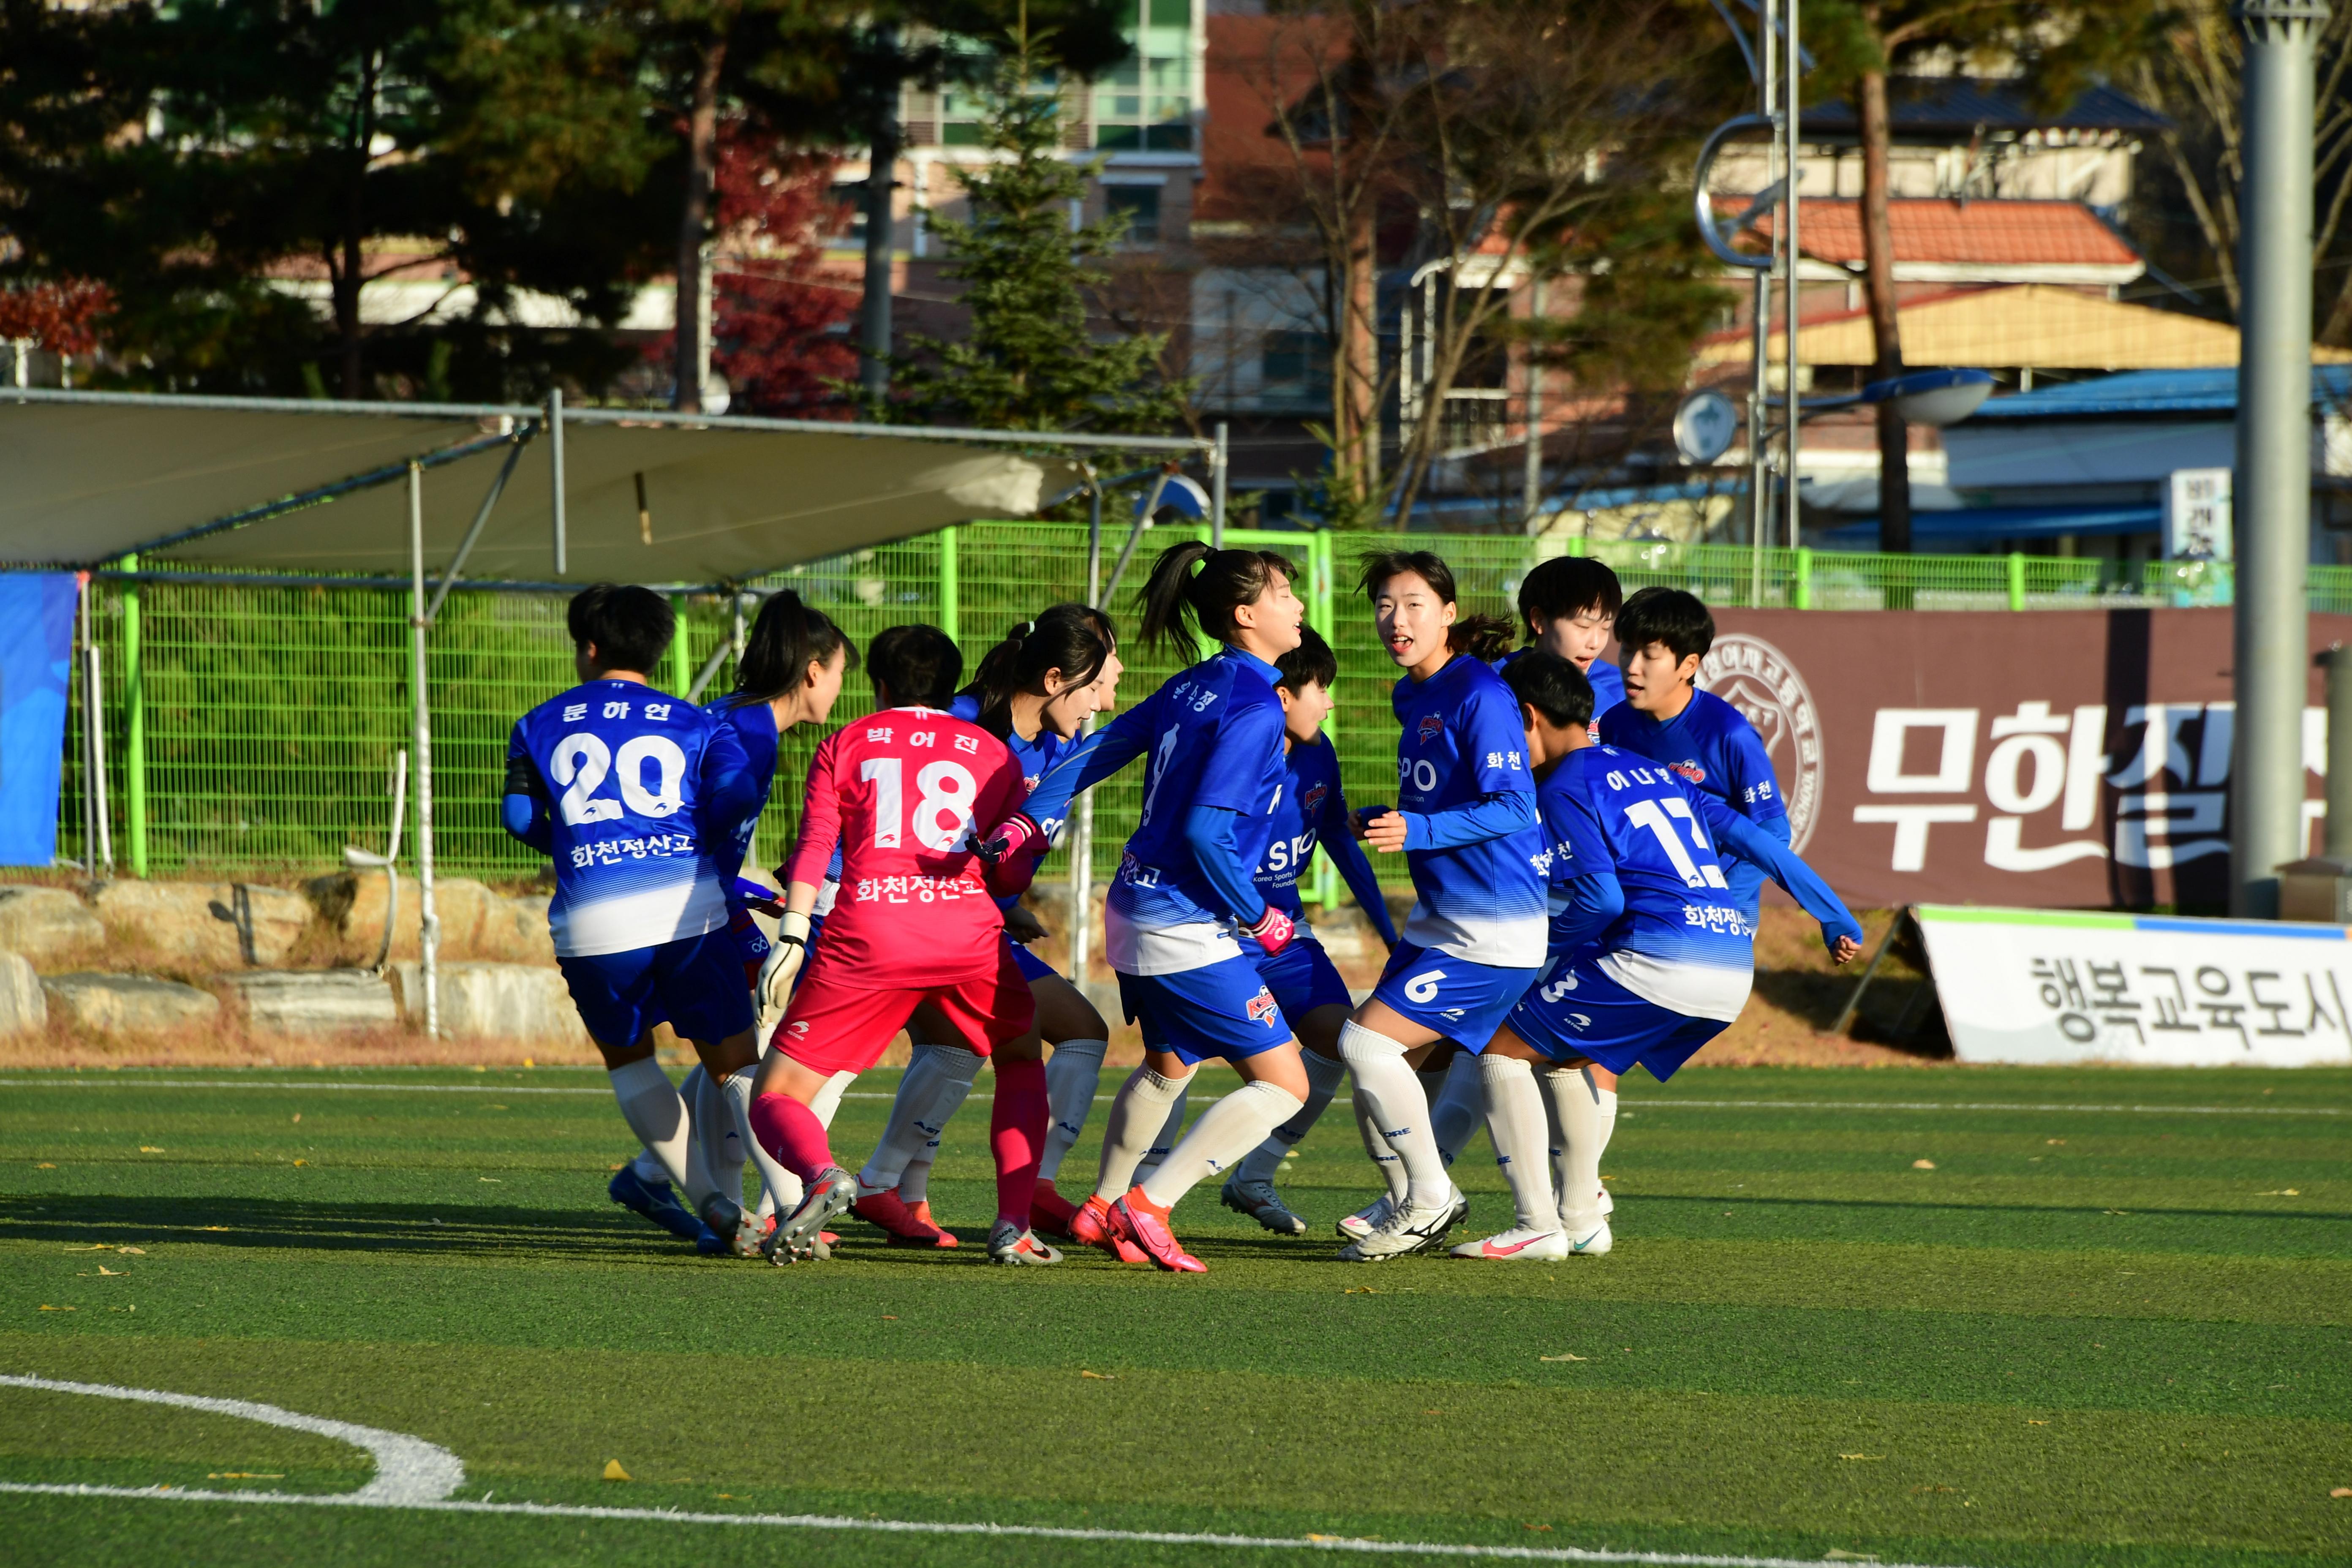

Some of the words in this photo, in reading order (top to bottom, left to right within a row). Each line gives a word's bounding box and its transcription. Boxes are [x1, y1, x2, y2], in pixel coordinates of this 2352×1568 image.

[866, 727, 979, 755] 박어진
[1486, 751, 1521, 770] 화천
[550, 732, 686, 826] 20
[1143, 723, 1180, 827] 9
[1853, 701, 2328, 872] 무한질
[860, 757, 977, 853] 18
[571, 833, 694, 869] 화천정산고
[1255, 828, 1317, 874] SPO
[856, 876, 984, 904] 화천정산고
[1404, 969, 1447, 1004] 6
[2030, 957, 2352, 1052] 행복교육도시
[1563, 1018, 1584, 1033] ASTORE
